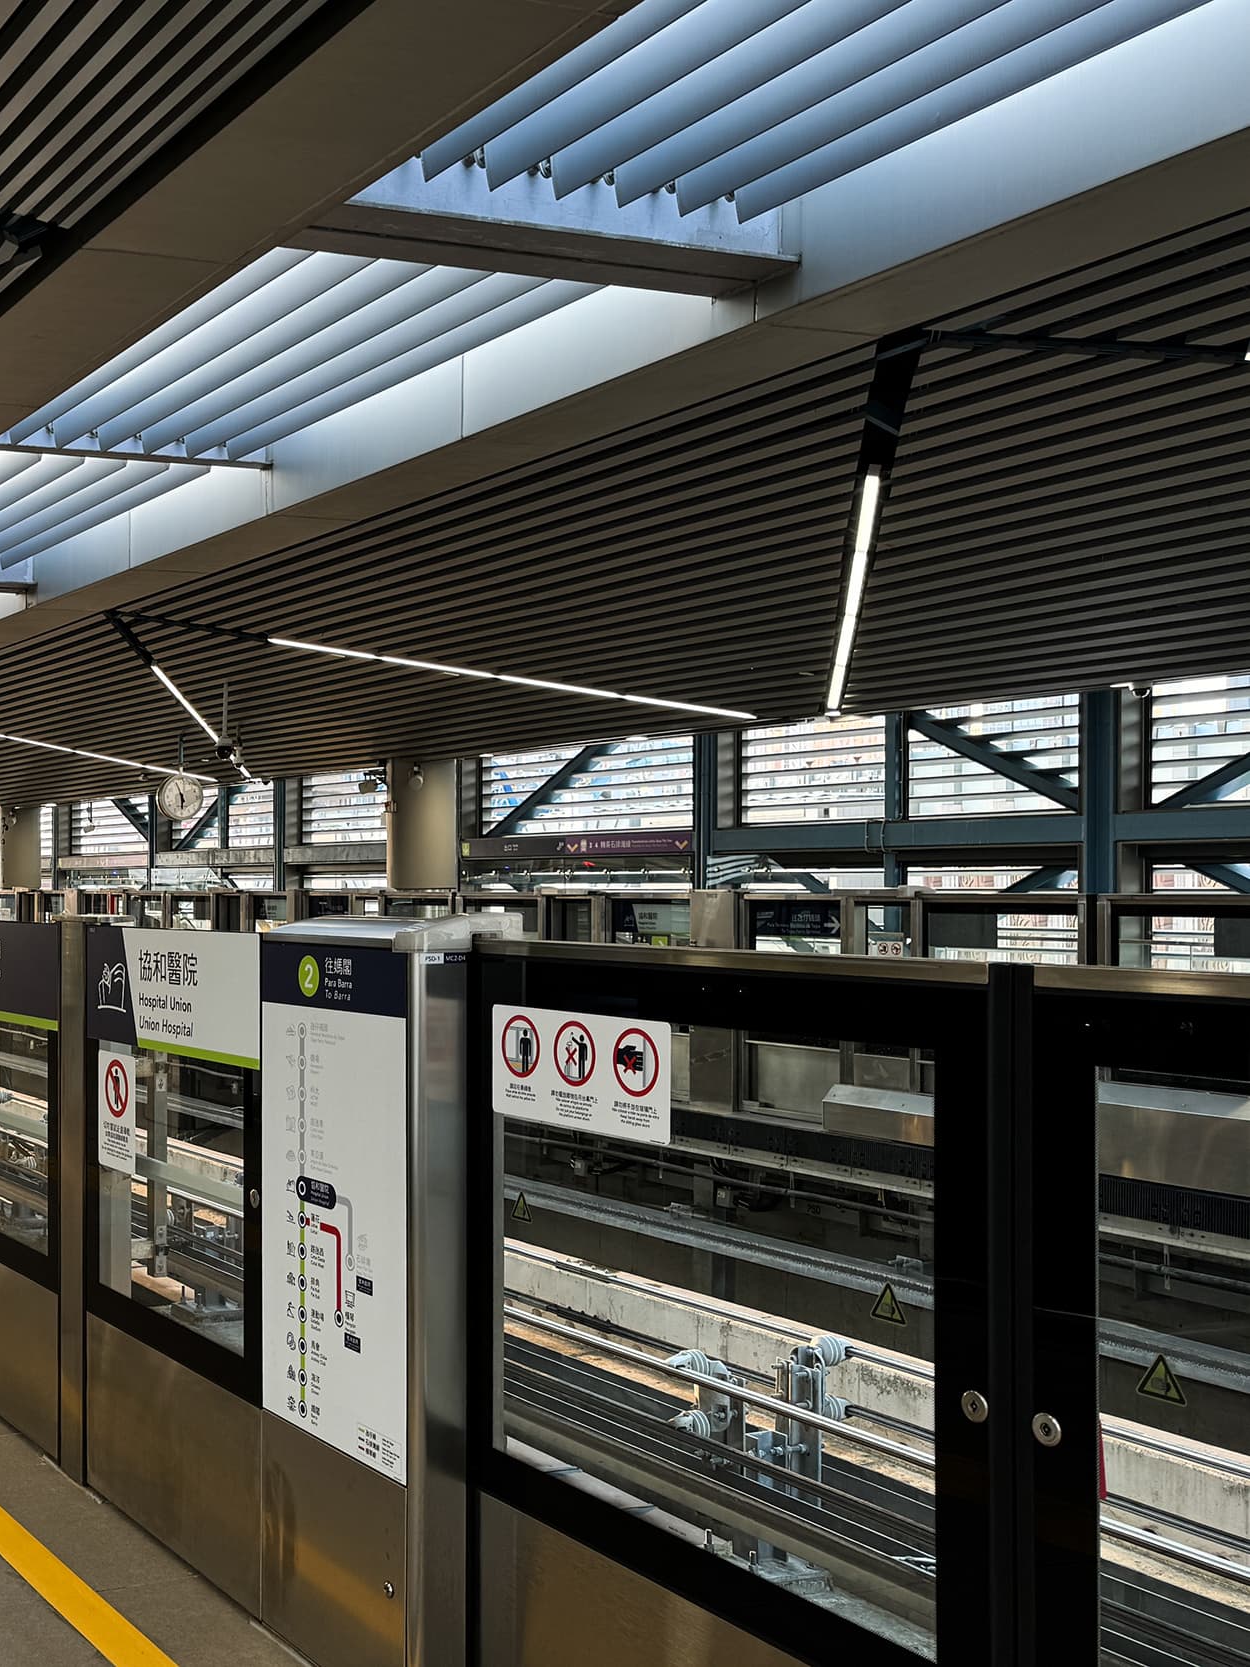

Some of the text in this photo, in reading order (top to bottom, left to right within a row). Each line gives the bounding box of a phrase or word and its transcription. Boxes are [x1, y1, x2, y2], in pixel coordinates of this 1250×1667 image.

[139, 949, 199, 987] 協和醫院
[304, 963, 314, 989] 2
[324, 956, 352, 975] 往媽閣
[324, 977, 352, 989] Para Barra
[139, 992, 192, 1013] Hospital Union
[325, 989, 351, 1001] To Barra
[139, 1015, 194, 1039] Union Hospital
